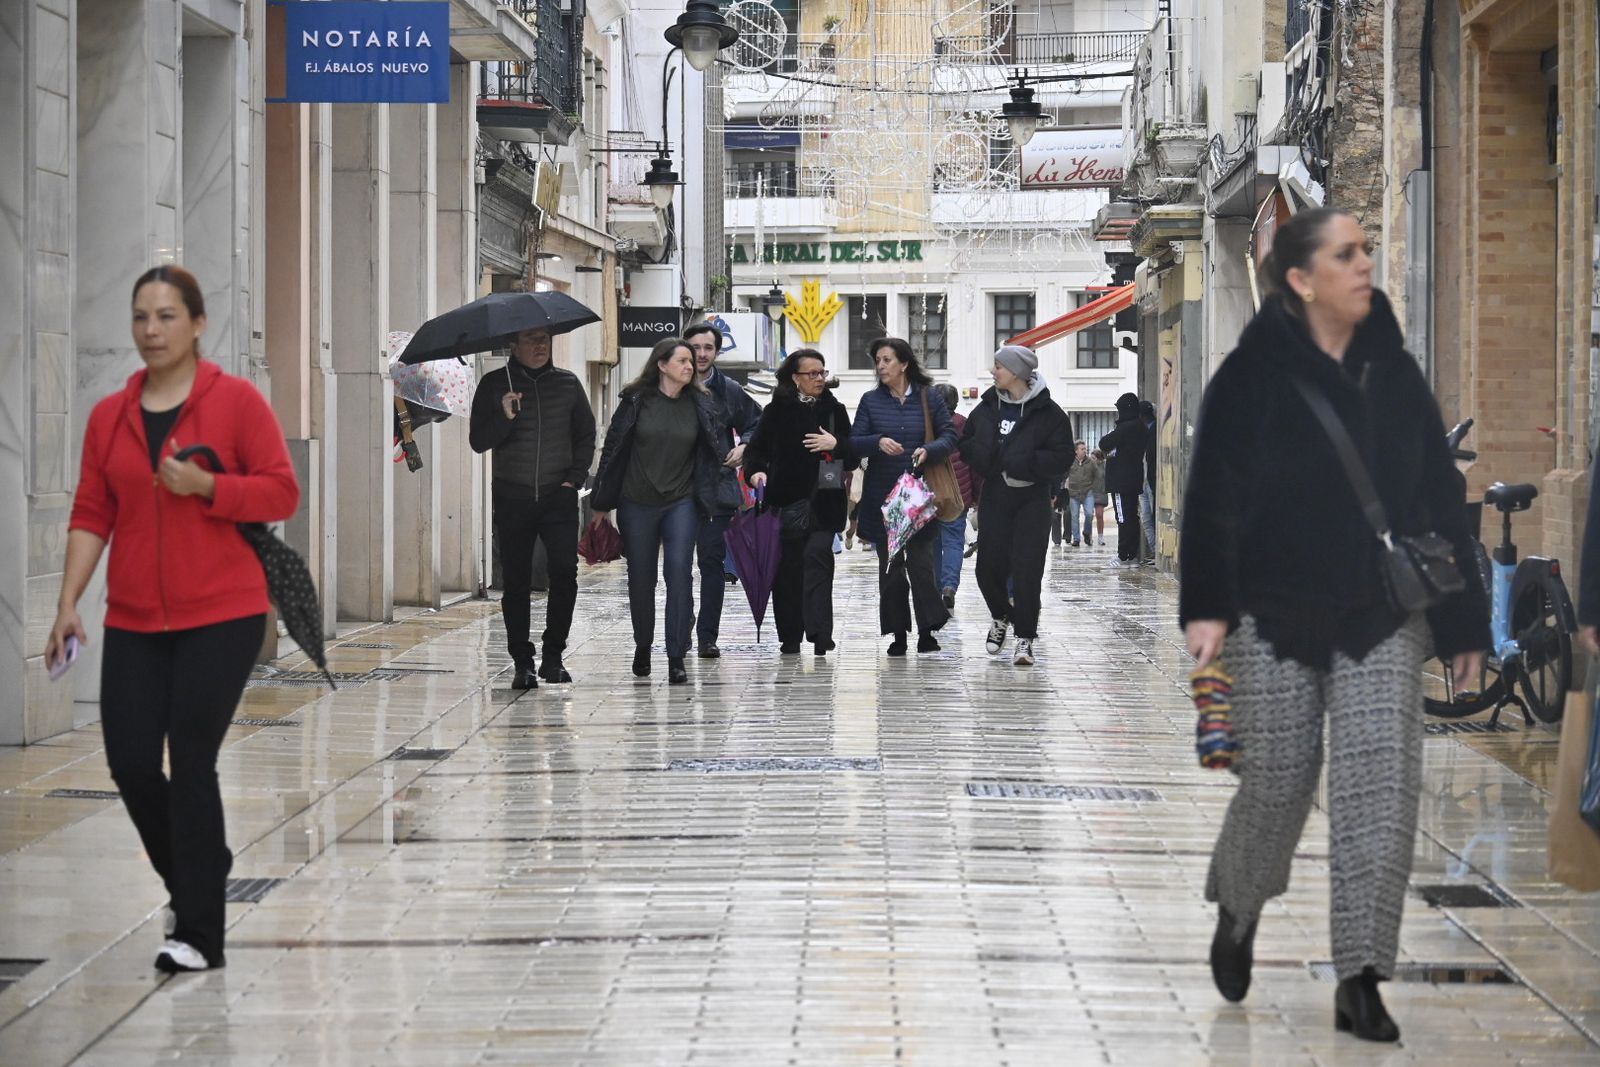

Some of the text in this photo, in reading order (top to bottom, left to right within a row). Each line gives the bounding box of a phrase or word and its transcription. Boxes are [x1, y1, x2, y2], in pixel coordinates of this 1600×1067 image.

[302, 26, 432, 48] NOTARÍA
[323, 59, 374, 73] ÁBALOS
[381, 62, 429, 73] NUEVO
[829, 241, 875, 262] DEL
[877, 240, 923, 262] SUR
[622, 322, 676, 333] MANGO
